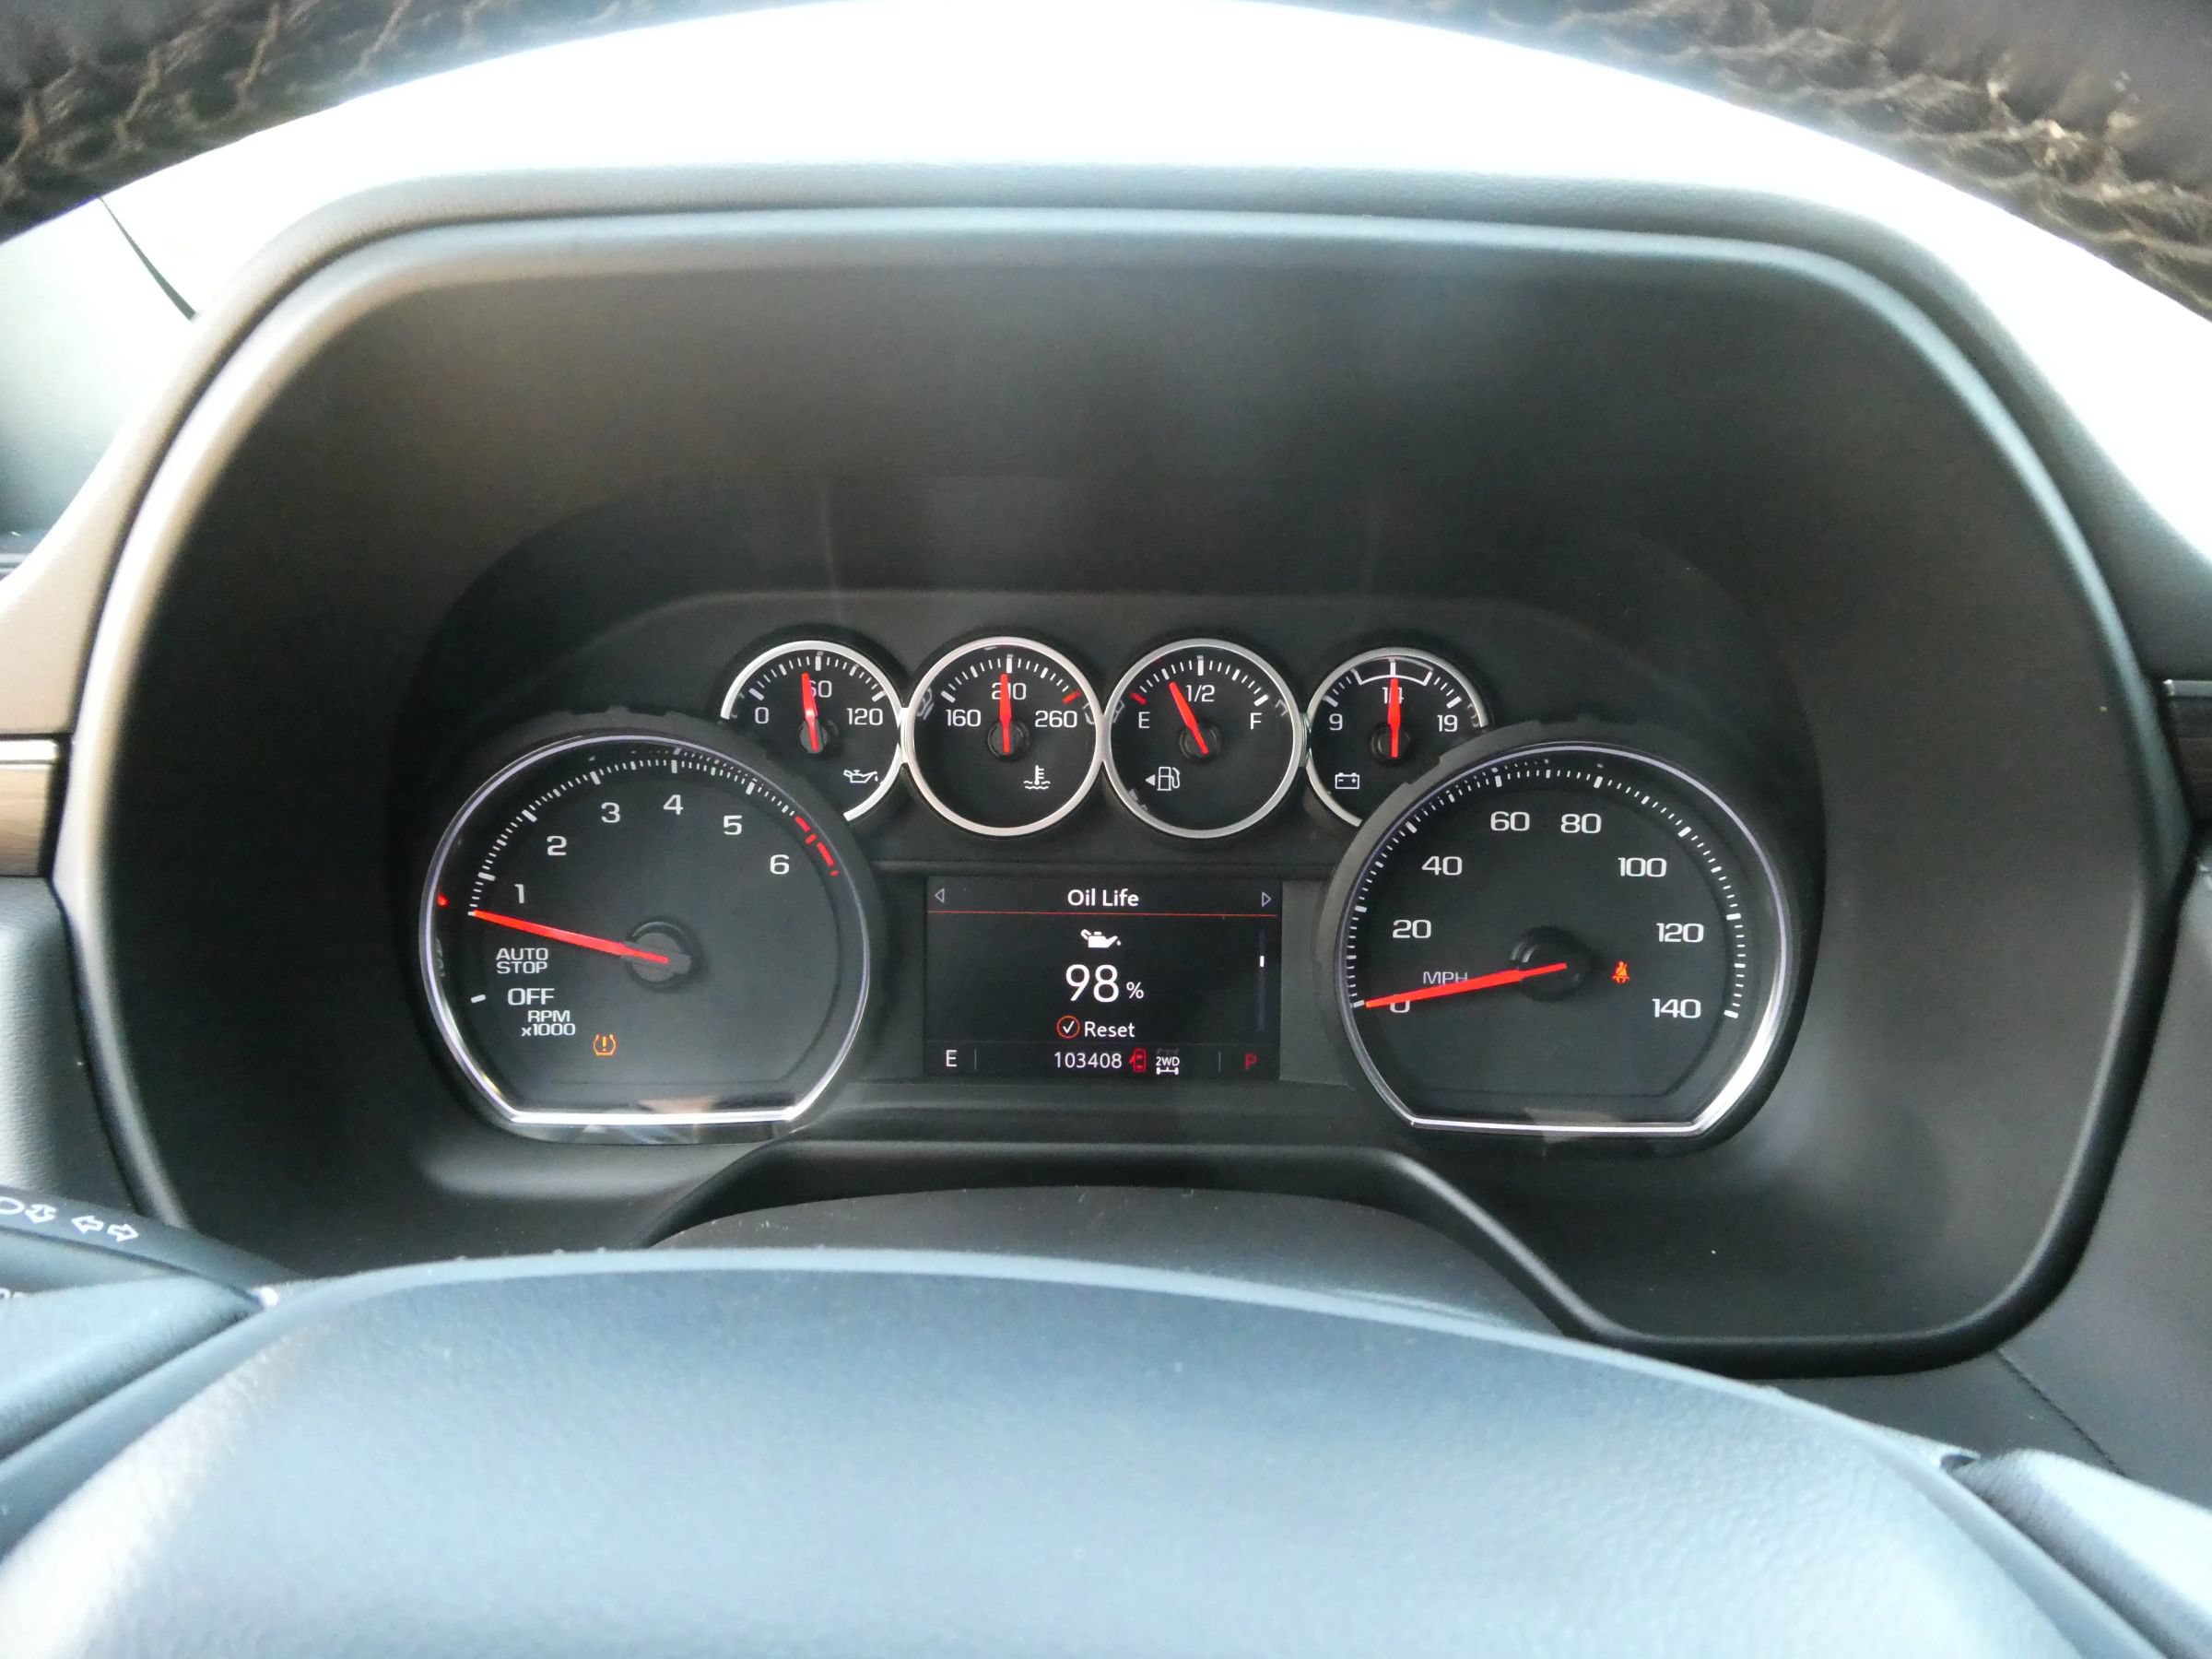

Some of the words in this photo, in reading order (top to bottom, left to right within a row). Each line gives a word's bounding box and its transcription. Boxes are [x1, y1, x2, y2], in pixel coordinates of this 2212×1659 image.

[1185, 684, 1216, 703] 1/2
[754, 706, 770, 724] 0
[846, 707, 884, 726] 120
[946, 709, 982, 727] 160
[1034, 710, 1078, 728] 260
[1138, 711, 1151, 729] E
[1250, 712, 1263, 730] F
[1328, 712, 1344, 731] 9
[1437, 714, 1458, 733] 19
[601, 802, 621, 824] 3
[663, 794, 684, 816] 4
[723, 815, 743, 836] 5
[1490, 810, 1531, 831] 60
[1560, 813, 1602, 834] 80
[547, 835, 568, 856] 2
[770, 853, 790, 875] 6
[1421, 855, 1463, 877] 40
[1618, 857, 1667, 878] 100
[514, 883, 525, 904] 1
[1067, 888, 1096, 907] Oil
[1102, 888, 1139, 907] Life
[1392, 919, 1432, 939] 20
[1655, 923, 1705, 943] 120
[495, 947, 549, 961] AUTO
[496, 960, 548, 974] STOP
[1065, 963, 1120, 1003] 98
[1125, 981, 1145, 999] %
[1422, 971, 1468, 986] MPH
[507, 987, 556, 1006] OFF
[527, 1009, 571, 1023] RPM
[1652, 998, 1701, 1019] 140
[521, 1022, 576, 1037] x1000
[1084, 1020, 1135, 1038] Reset
[946, 1049, 958, 1067] E
[1054, 1051, 1123, 1069] 103408
[1155, 1056, 1181, 1067] 2WD
[1243, 1053, 1258, 1070] P
